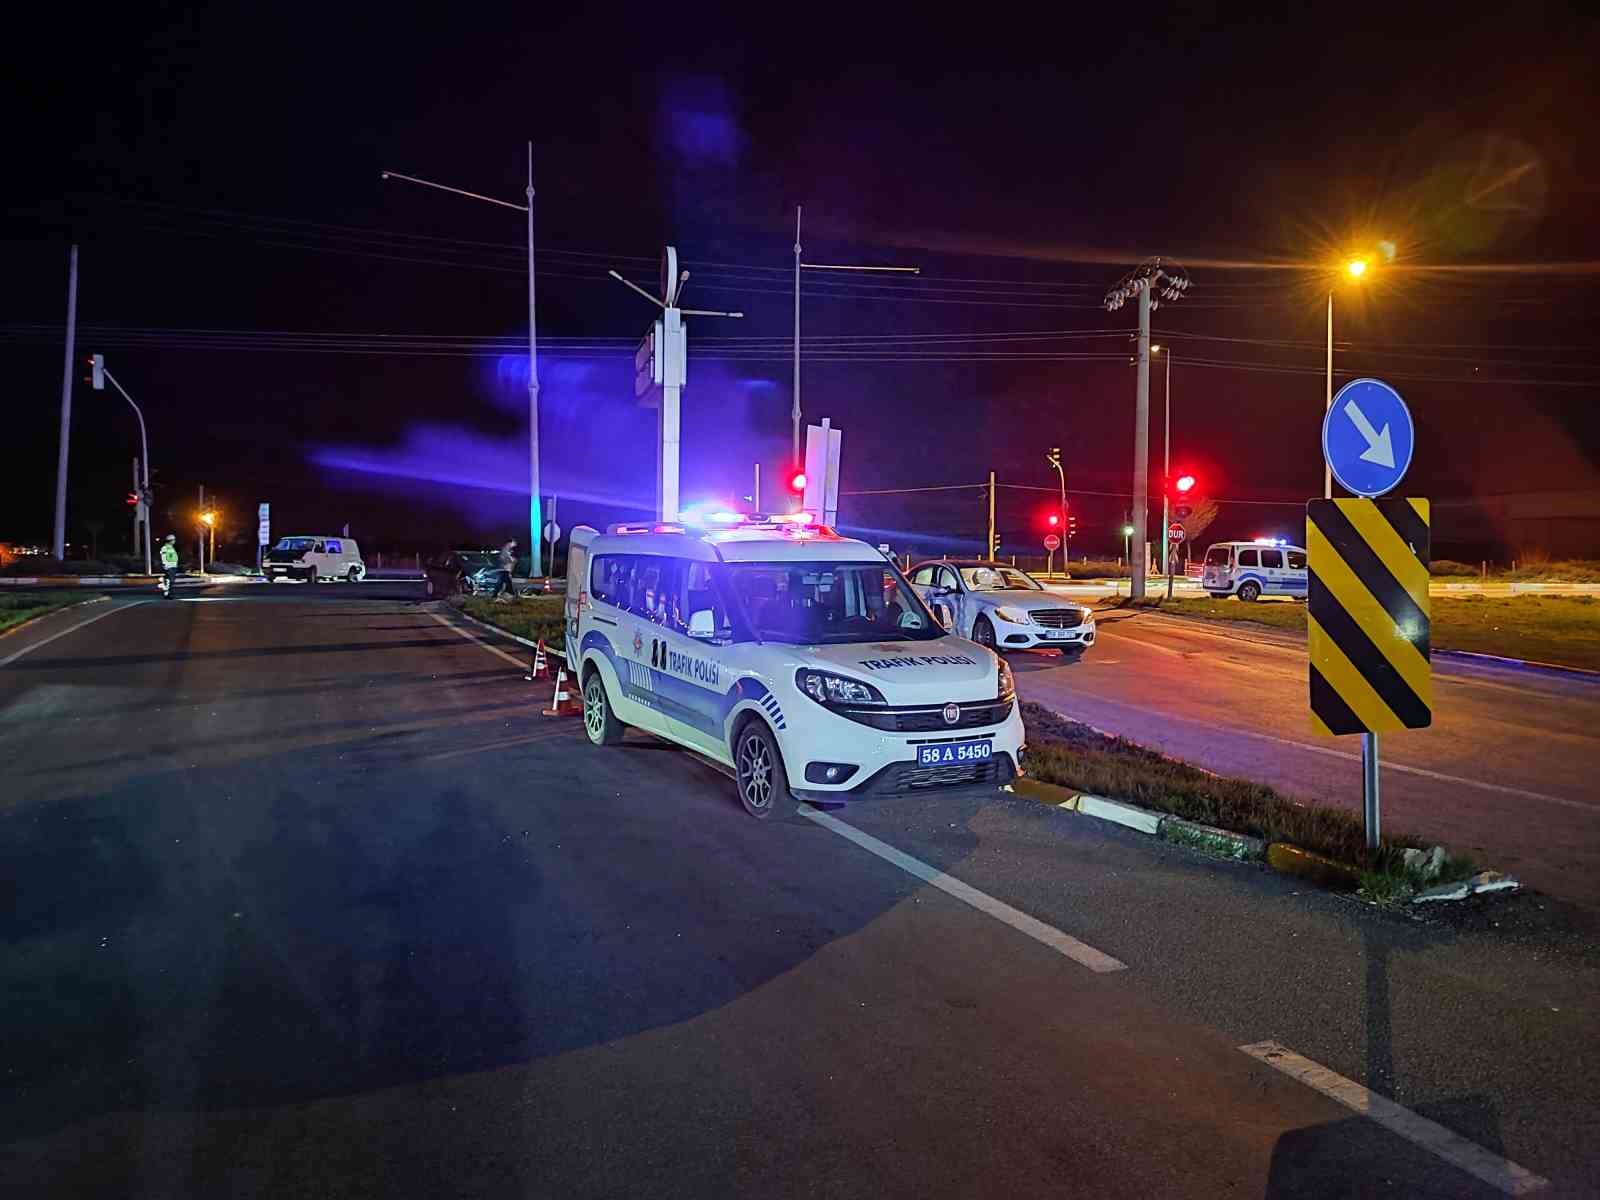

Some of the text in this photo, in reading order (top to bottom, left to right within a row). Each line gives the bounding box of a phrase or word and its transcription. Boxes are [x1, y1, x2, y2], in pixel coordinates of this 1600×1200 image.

[1168, 529, 1184, 539] DUR
[922, 744, 990, 763] 58 A 5450
